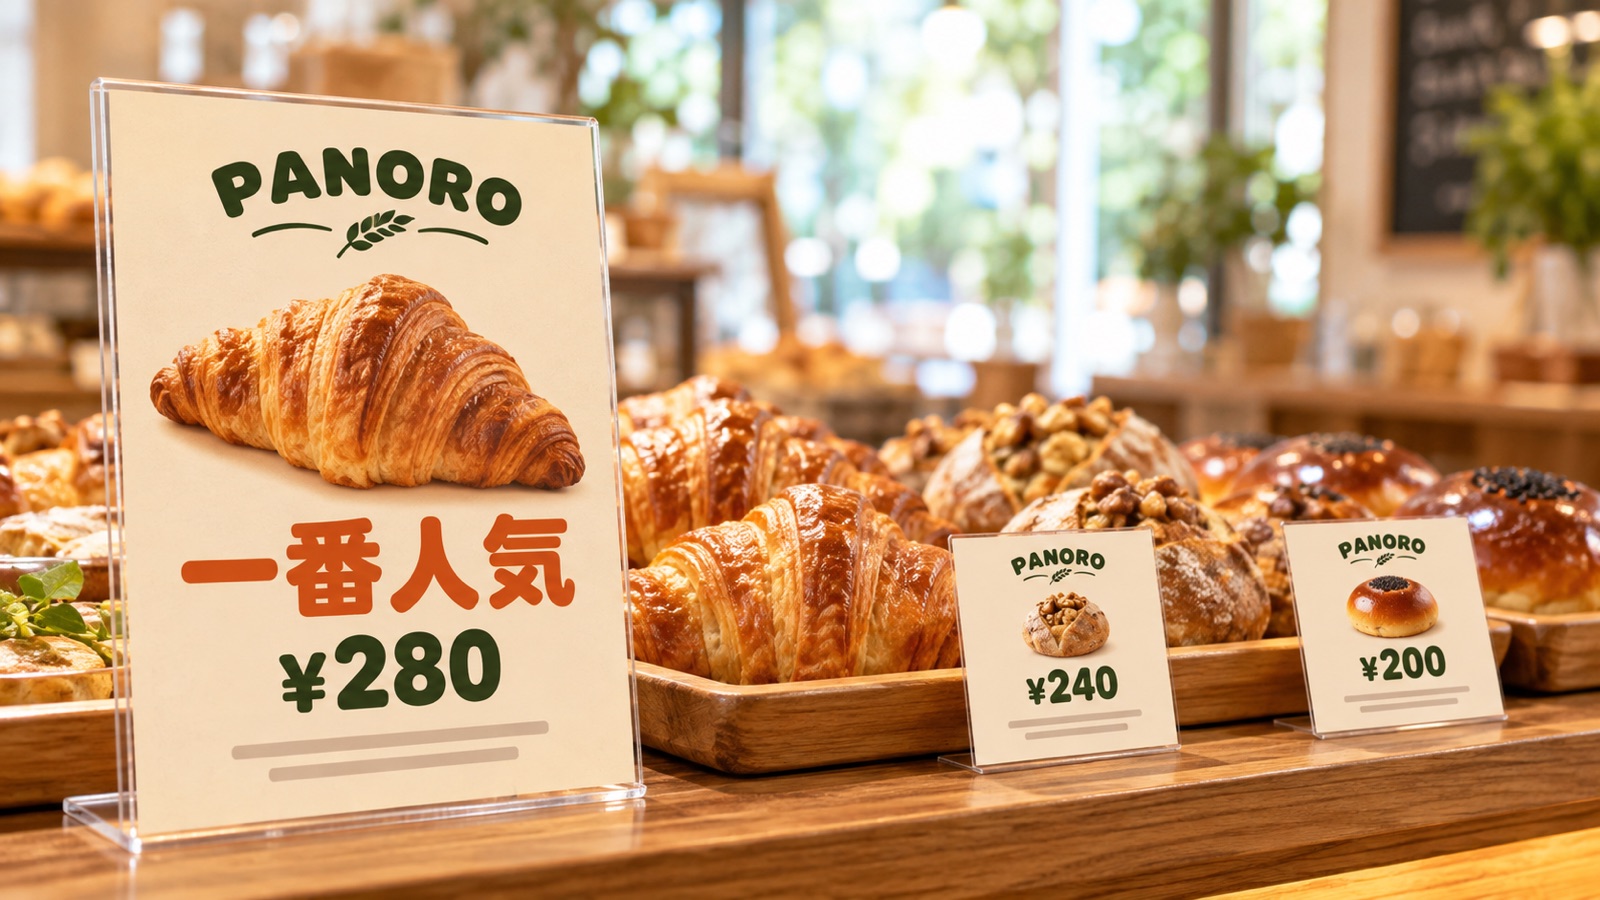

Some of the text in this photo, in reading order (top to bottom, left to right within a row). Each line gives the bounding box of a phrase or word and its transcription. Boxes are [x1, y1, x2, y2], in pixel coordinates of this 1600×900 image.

[211, 147, 523, 227] PANORO
[180, 513, 576, 618] 一番人気
[1010, 547, 1106, 576] PANORO
[1338, 533, 1426, 560] PANORO
[278, 628, 502, 714] ¥280
[1359, 645, 1446, 682] ¥200
[1025, 665, 1119, 706] ¥240
